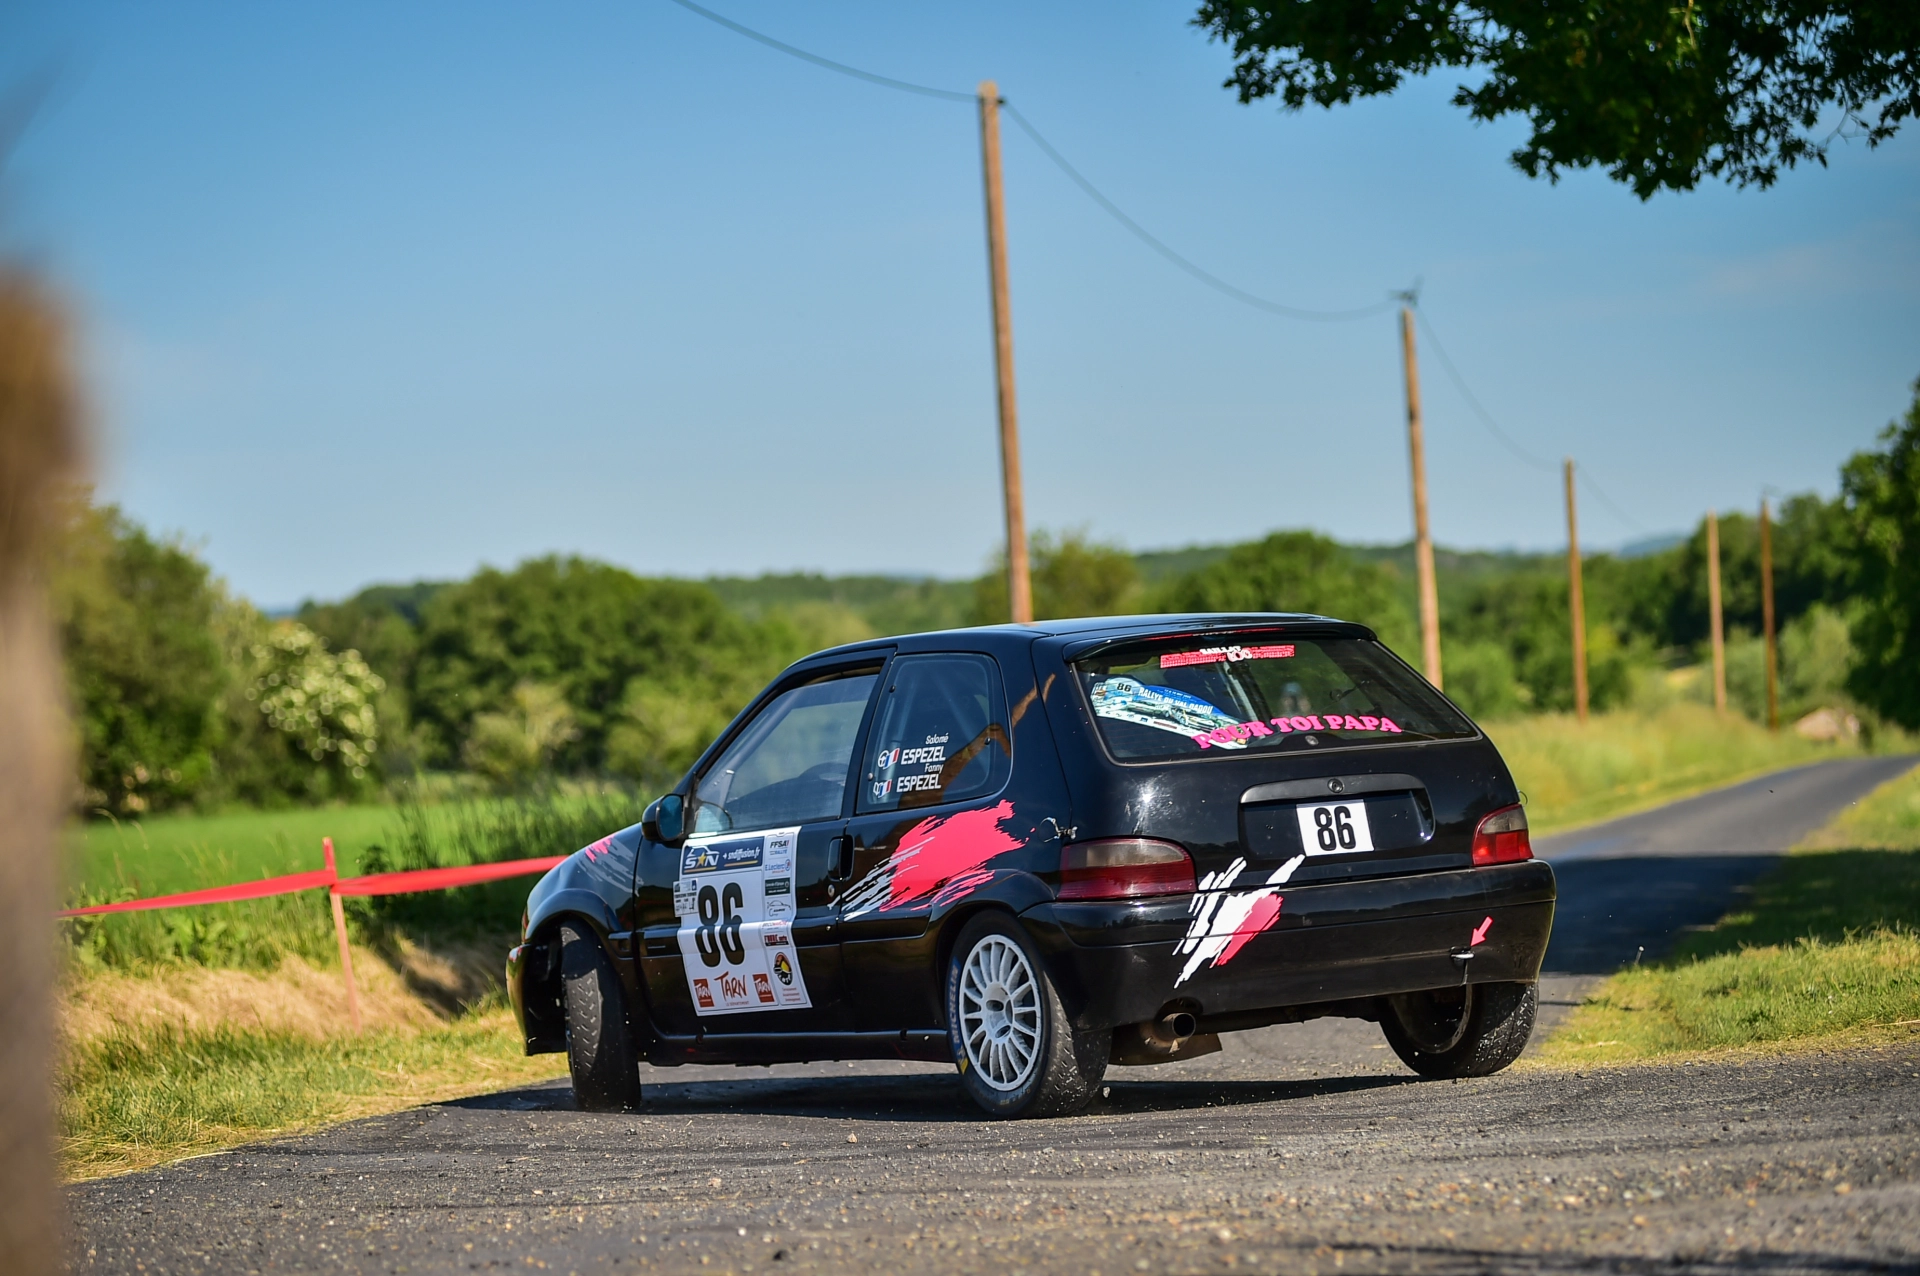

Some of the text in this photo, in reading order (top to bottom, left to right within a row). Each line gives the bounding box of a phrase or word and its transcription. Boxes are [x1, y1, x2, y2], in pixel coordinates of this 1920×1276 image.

[1116, 682, 1132, 693] 86
[1138, 687, 1162, 702] RALLYE
[1175, 699, 1190, 708] VAL
[925, 733, 949, 744] Salomé
[1192, 721, 1273, 749] POUR
[1271, 715, 1324, 732] TOI
[1323, 715, 1402, 732] PAPA
[901, 746, 946, 765] ESPEZEL
[924, 763, 944, 773] Fanny
[896, 774, 941, 792] ESPEZEL
[1314, 806, 1356, 851] 86
[728, 847, 760, 860] sndiffusion.fr
[695, 882, 745, 968] 86
[694, 983, 711, 997] TARN
[713, 971, 747, 1001] TARN
[752, 978, 770, 993] TARN
[950, 964, 960, 1044] MICHELIN
